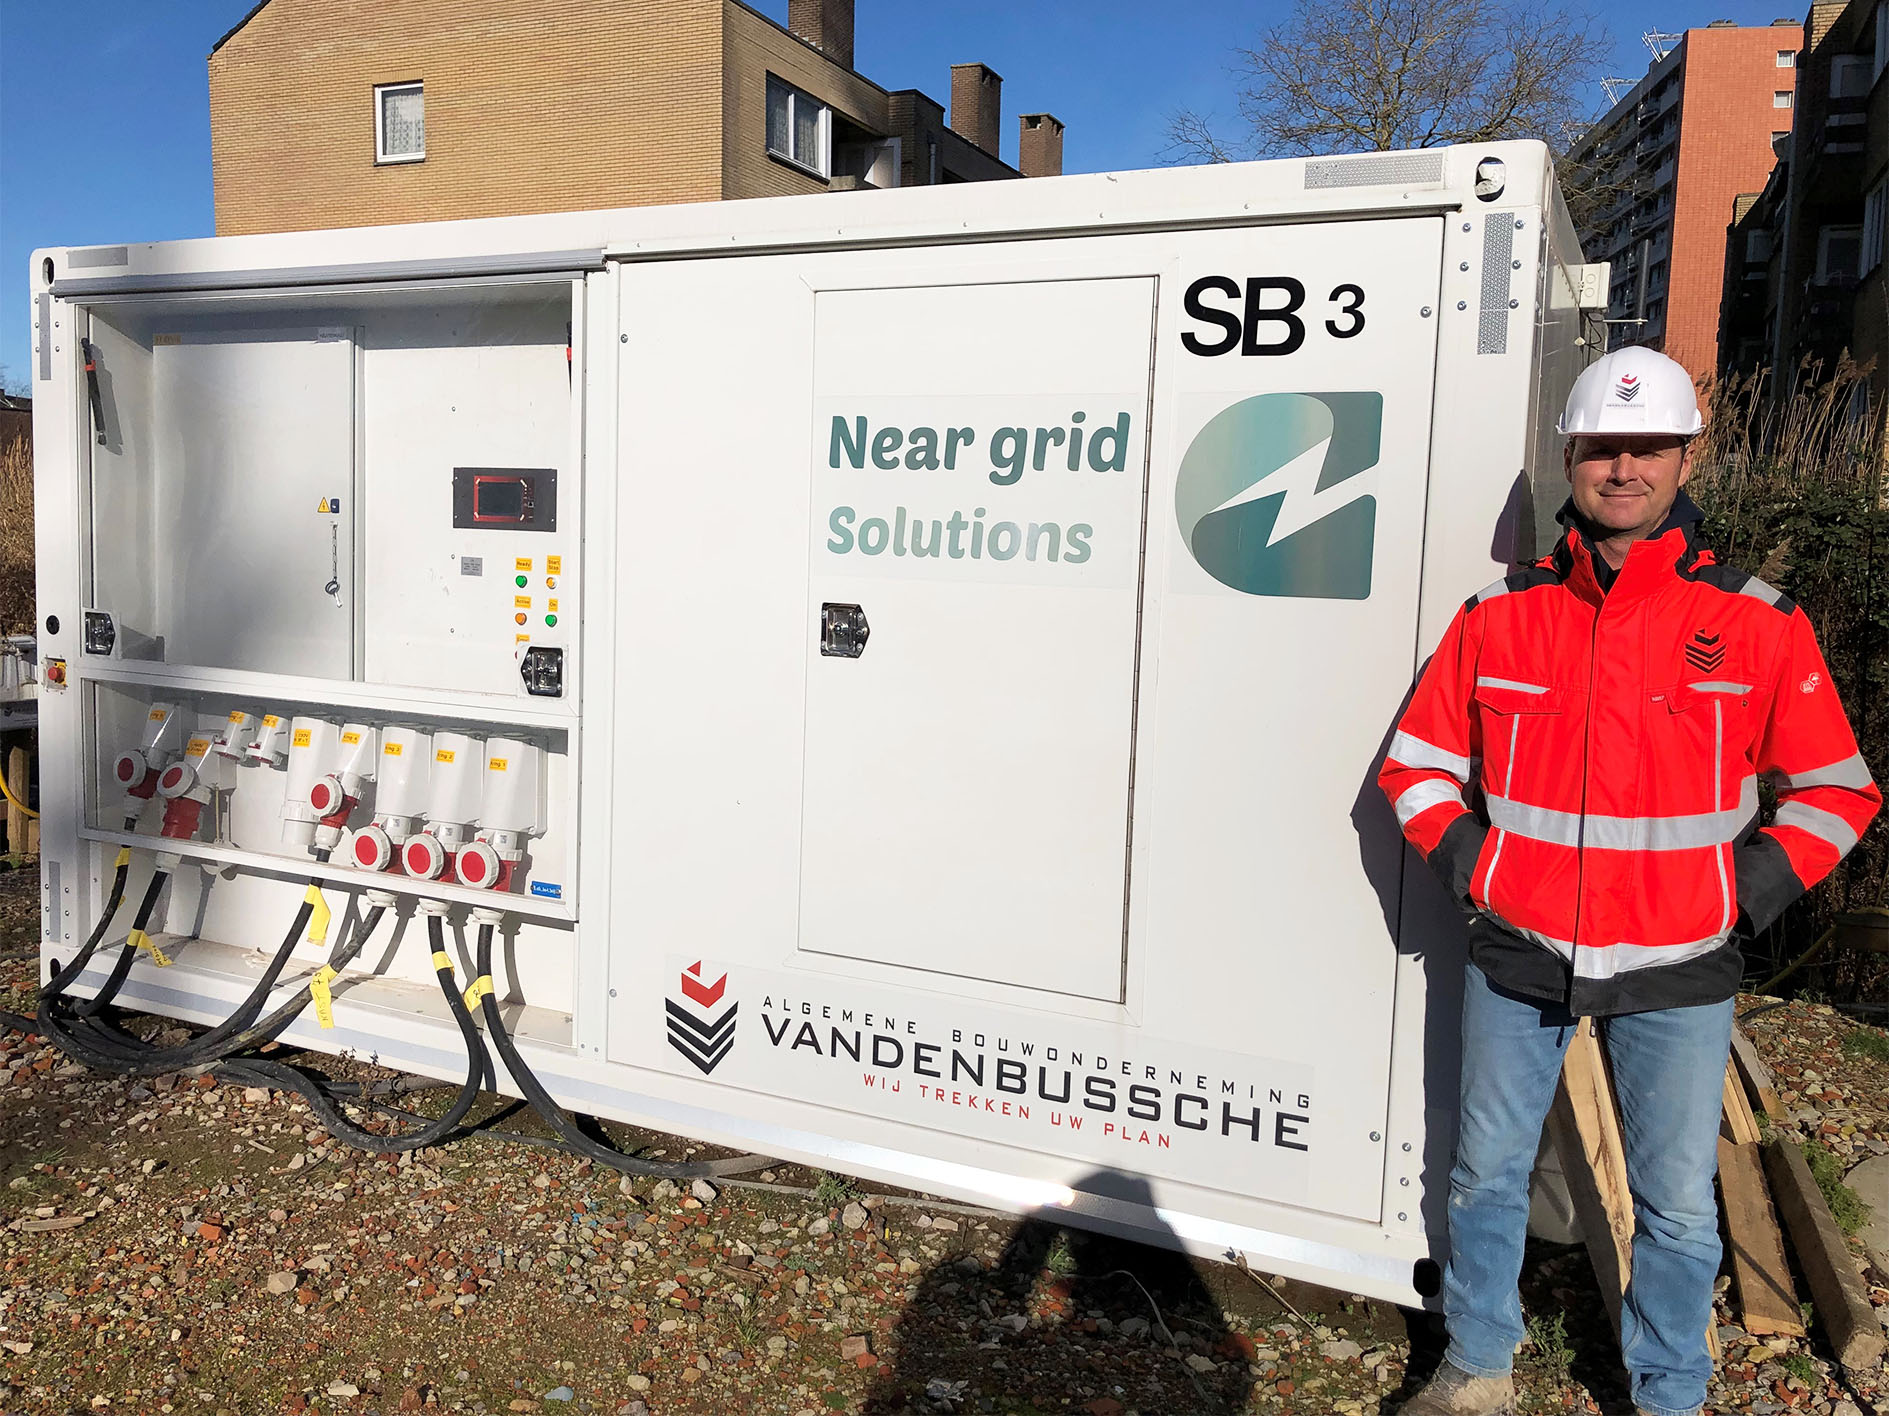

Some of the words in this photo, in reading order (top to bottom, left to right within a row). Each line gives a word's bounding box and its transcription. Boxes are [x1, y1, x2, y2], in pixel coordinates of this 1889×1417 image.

[1181, 276, 1306, 358] SB
[1325, 284, 1366, 339] 3
[829, 415, 976, 471] Near
[988, 411, 1131, 487] grid
[827, 506, 1094, 564] Solutions
[761, 1014, 1310, 1152] VANDENBUSSCHE
[763, 995, 917, 1035] ALGEMENE
[952, 1029, 1310, 1109] BOUWONDERNEMING
[863, 1073, 901, 1093] WIJ
[919, 1084, 1030, 1119] TREKKEN
[1050, 1111, 1083, 1130] UW
[1103, 1122, 1170, 1149] PLAN
